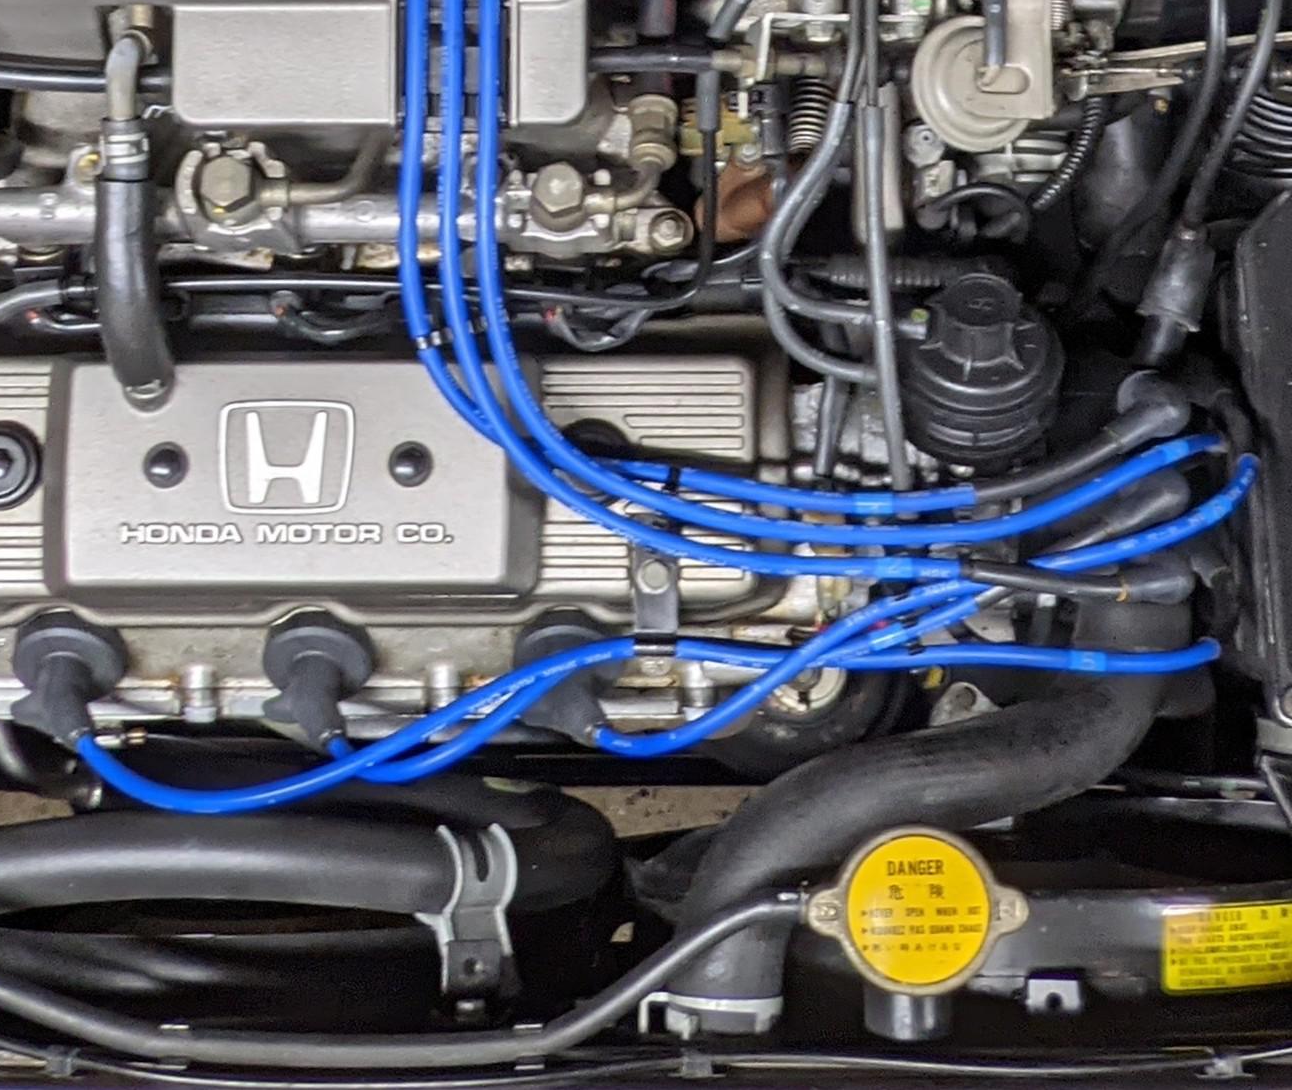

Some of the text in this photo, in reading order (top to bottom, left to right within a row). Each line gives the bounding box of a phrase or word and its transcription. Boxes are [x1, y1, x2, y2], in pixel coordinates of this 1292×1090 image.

[120, 523, 454, 545] HONDA MOTOR CO.
[886, 860, 944, 876] DANGER
